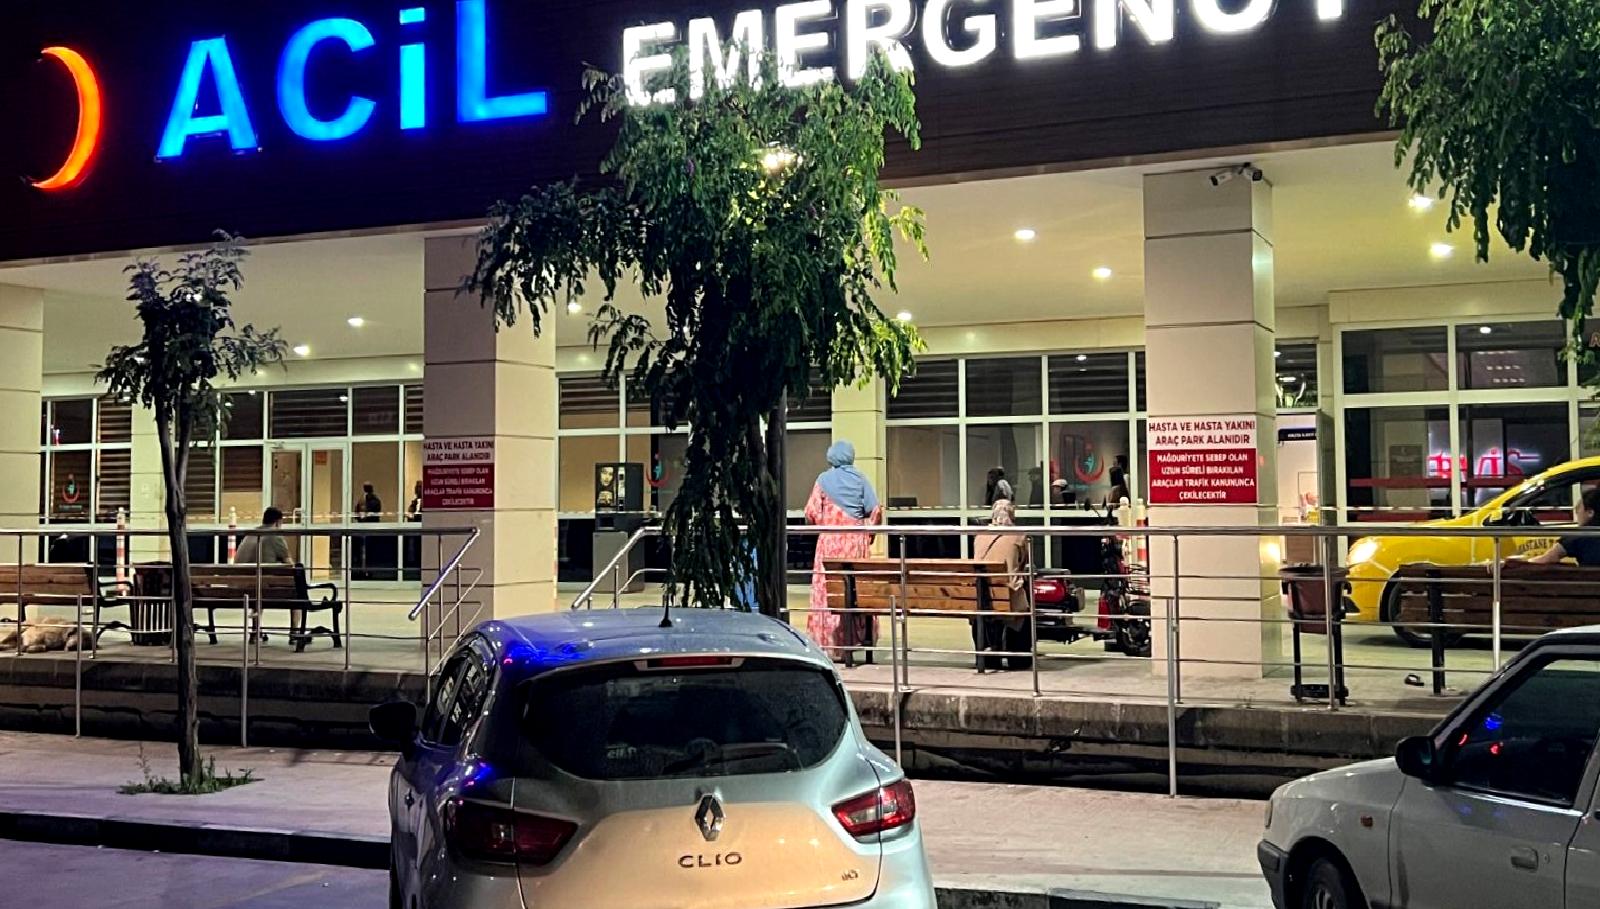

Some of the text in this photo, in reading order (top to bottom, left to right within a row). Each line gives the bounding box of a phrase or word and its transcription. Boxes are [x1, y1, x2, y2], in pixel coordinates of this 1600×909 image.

[623, 0, 1342, 106] EMERGEN
[1149, 420, 1255, 431] HASTA VE HASTA YAKINI
[1155, 434, 1250, 446] ARAÇ PARK ALANIDIR
[1228, 453, 1248, 462] OLAN
[678, 852, 742, 868] CLIO
